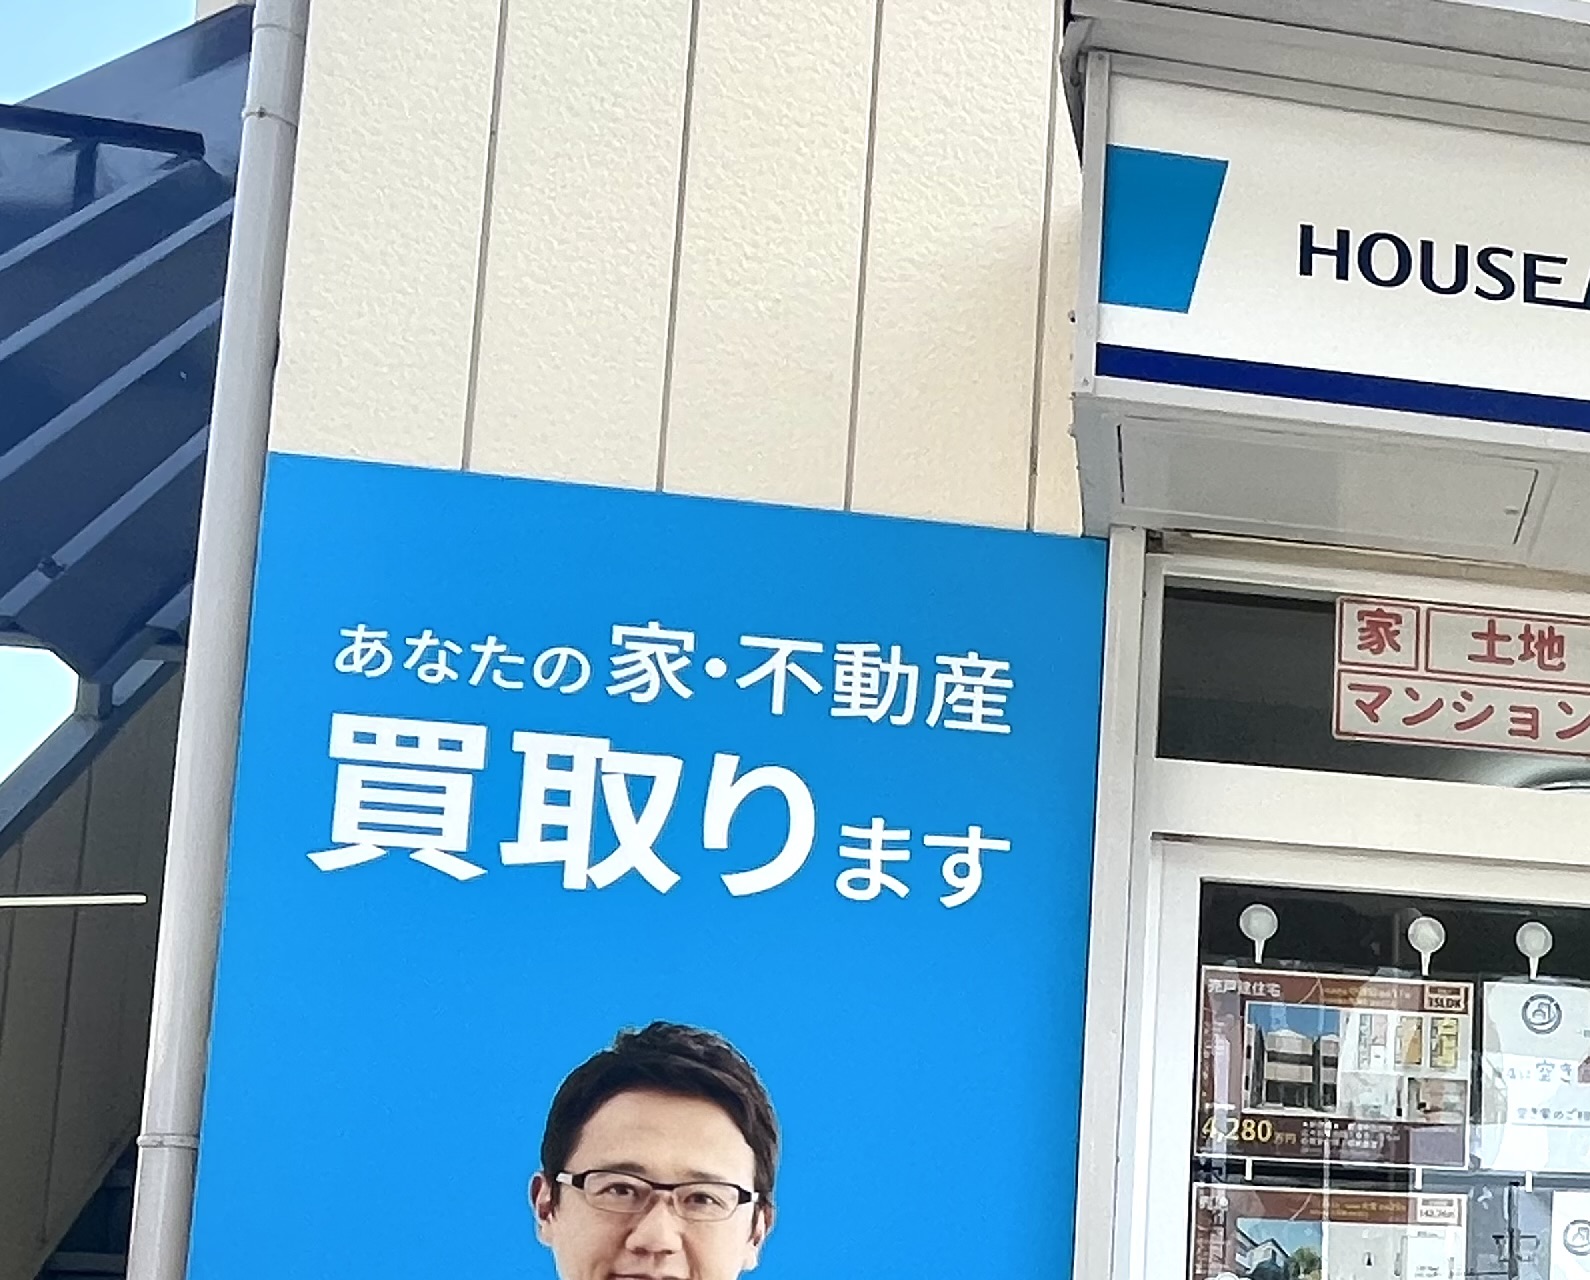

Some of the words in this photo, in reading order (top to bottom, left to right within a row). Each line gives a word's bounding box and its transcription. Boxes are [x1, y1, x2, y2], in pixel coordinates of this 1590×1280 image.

[1357, 608, 1402, 655] 家
[1468, 619, 1567, 671] 土地
[306, 713, 1011, 909] 買取ります
